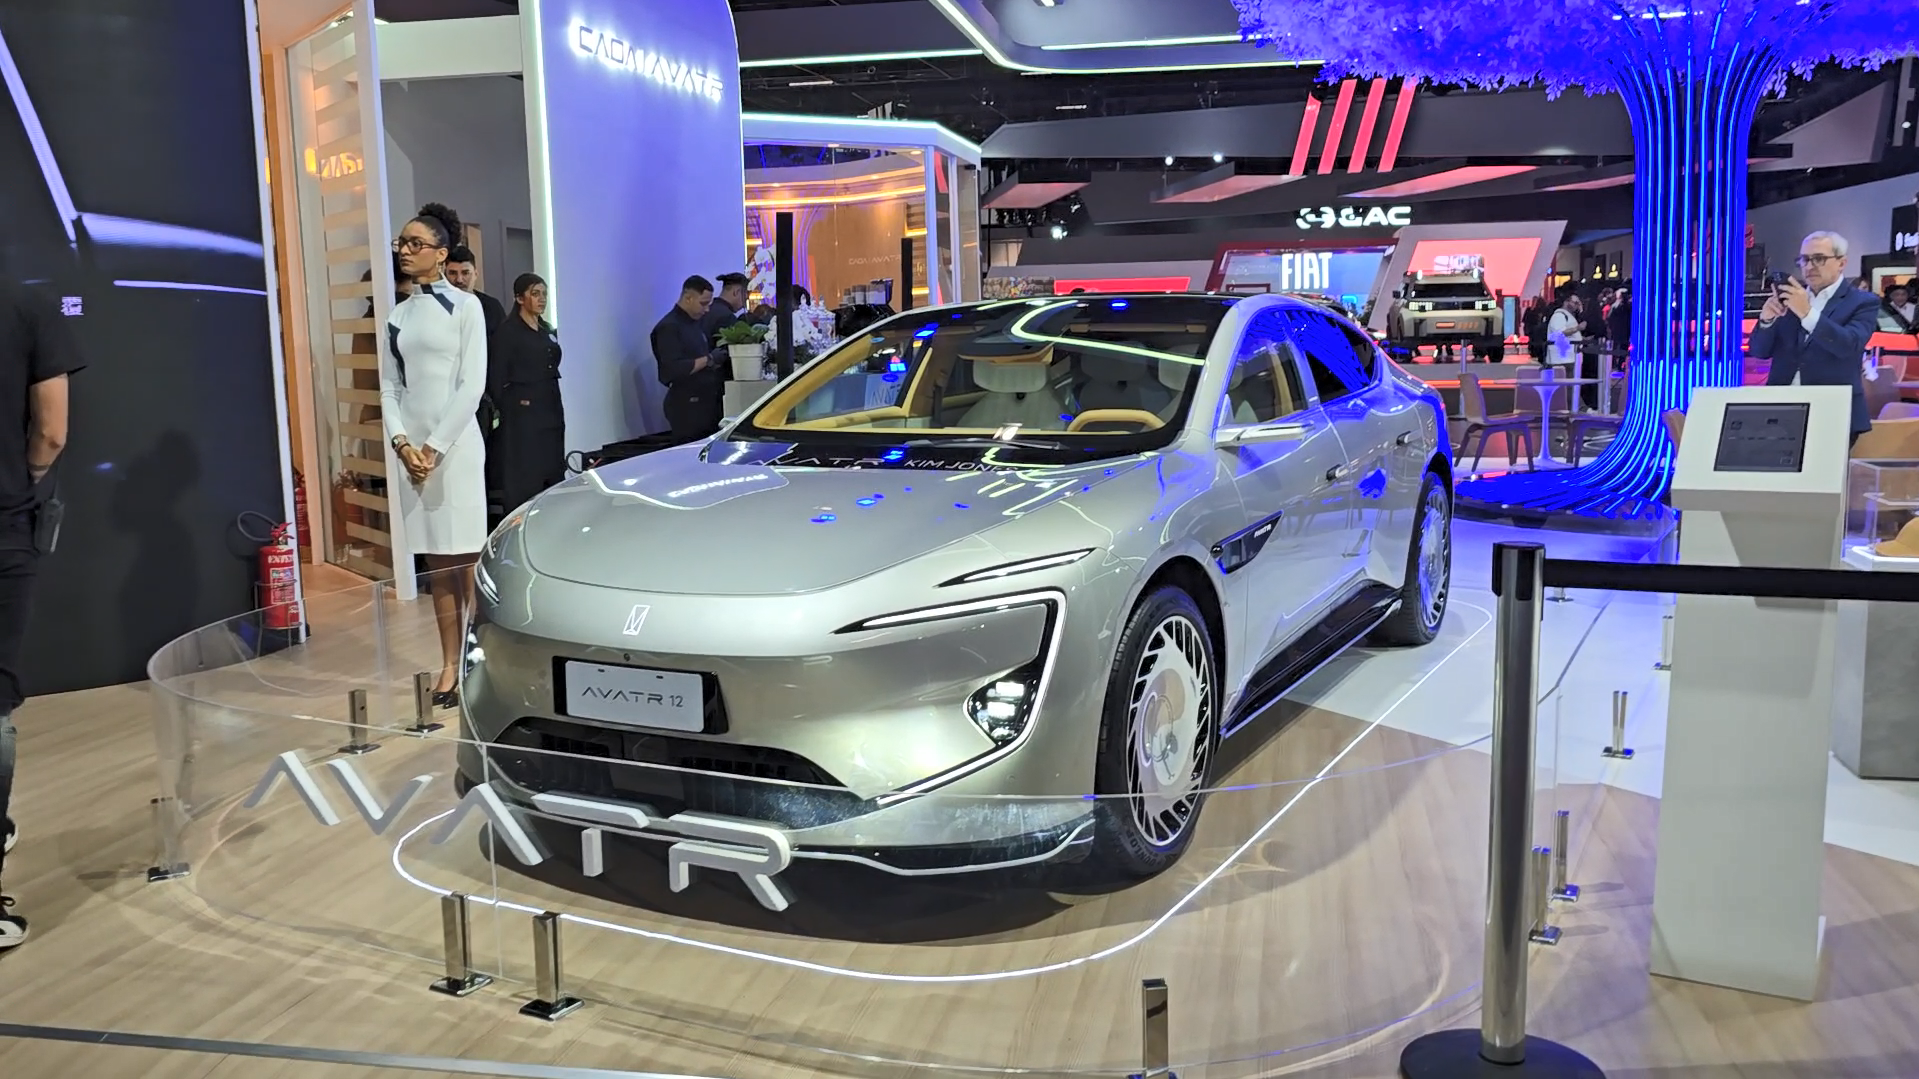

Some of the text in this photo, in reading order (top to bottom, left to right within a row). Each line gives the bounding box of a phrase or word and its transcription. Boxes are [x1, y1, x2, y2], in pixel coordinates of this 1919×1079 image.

[579, 26, 724, 98] CAOA AVATR
[1281, 252, 1332, 290] FIAT
[904, 459, 945, 468] KIM
[582, 686, 684, 708] AVATR 12
[243, 751, 793, 912] AVATR
[1125, 829, 1157, 867] DUNLOP
